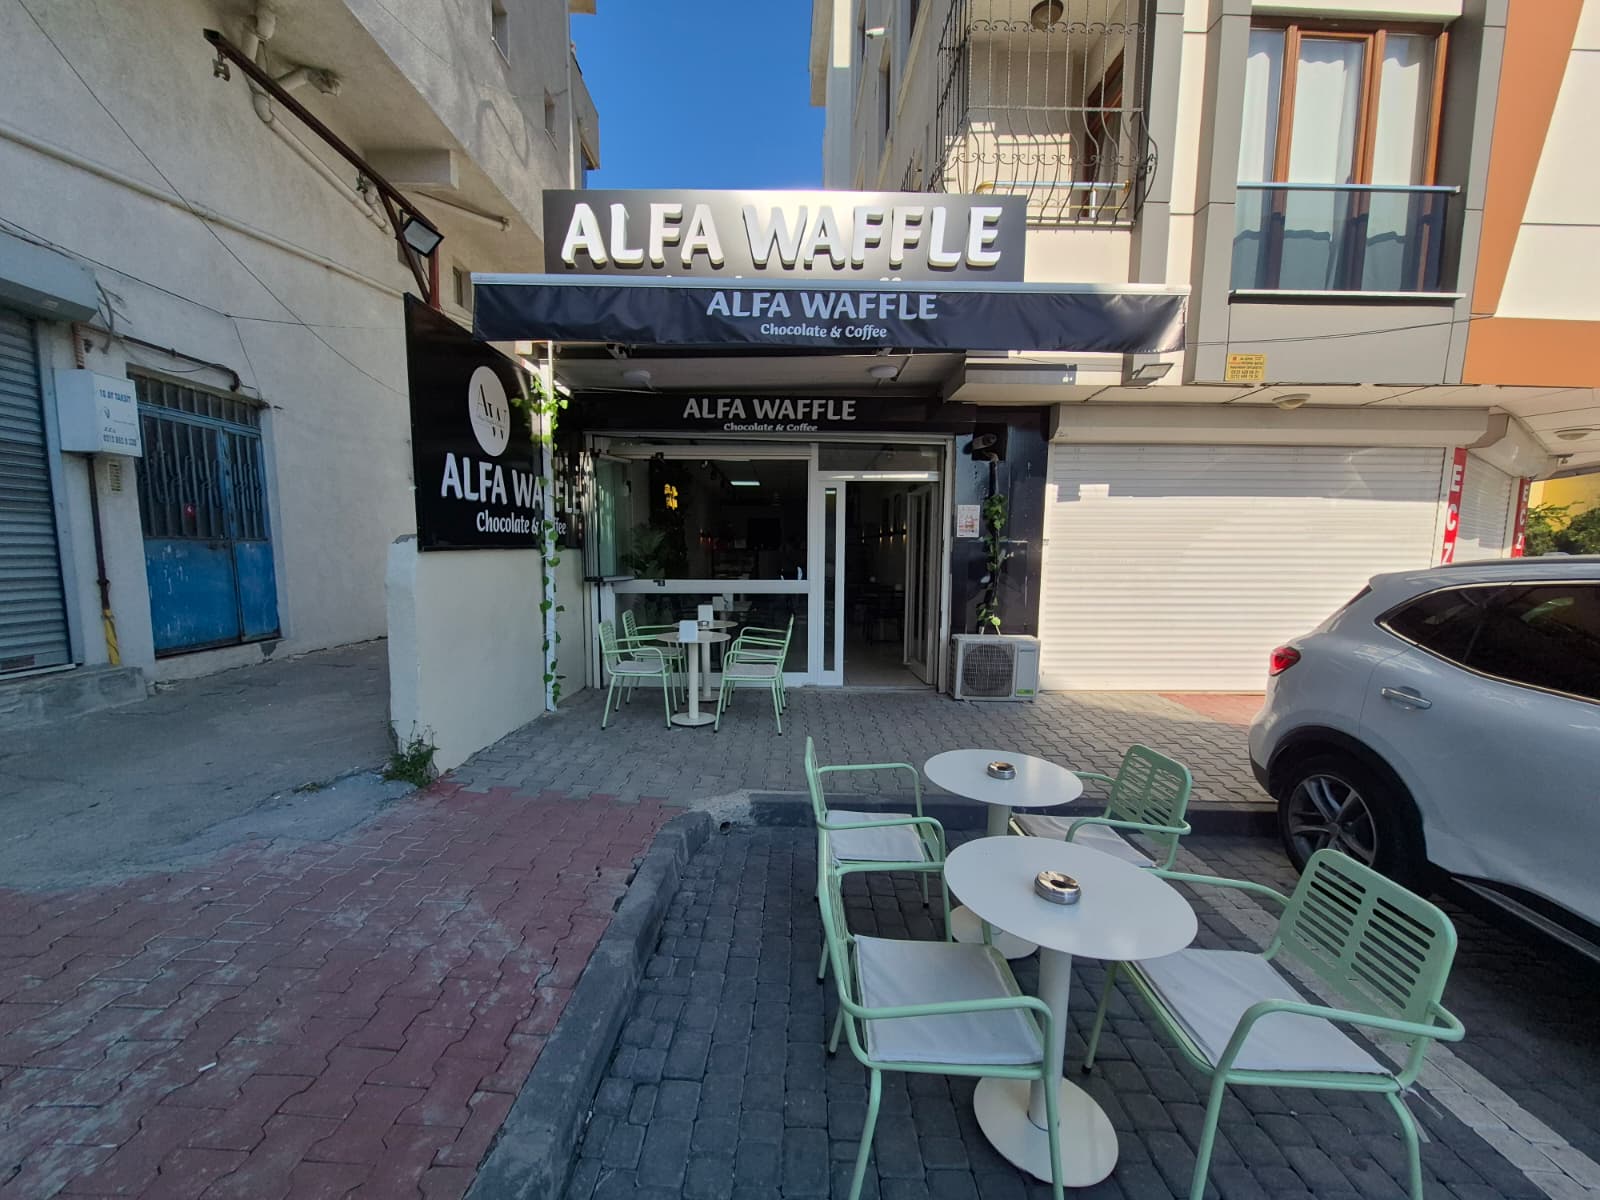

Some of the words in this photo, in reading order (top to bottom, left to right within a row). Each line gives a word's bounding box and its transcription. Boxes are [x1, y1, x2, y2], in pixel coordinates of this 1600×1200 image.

[560, 203, 724, 267] ALFA
[742, 205, 1003, 268] WAFFLE
[706, 290, 791, 318] ALFA
[800, 292, 938, 320] WAFFLE
[760, 323, 827, 338] Chocolate
[829, 326, 841, 338] &
[845, 324, 887, 340] Coffee
[683, 398, 746, 420] ALFA
[752, 399, 856, 421] WAFFLE
[723, 422, 774, 432] Chocolate
[775, 422, 785, 432] &
[786, 422, 818, 432] Coffee
[441, 452, 507, 505] ALFA
[511, 469, 580, 514] WAFLE
[476, 509, 530, 533] Chocolate
[531, 516, 540, 536] &
